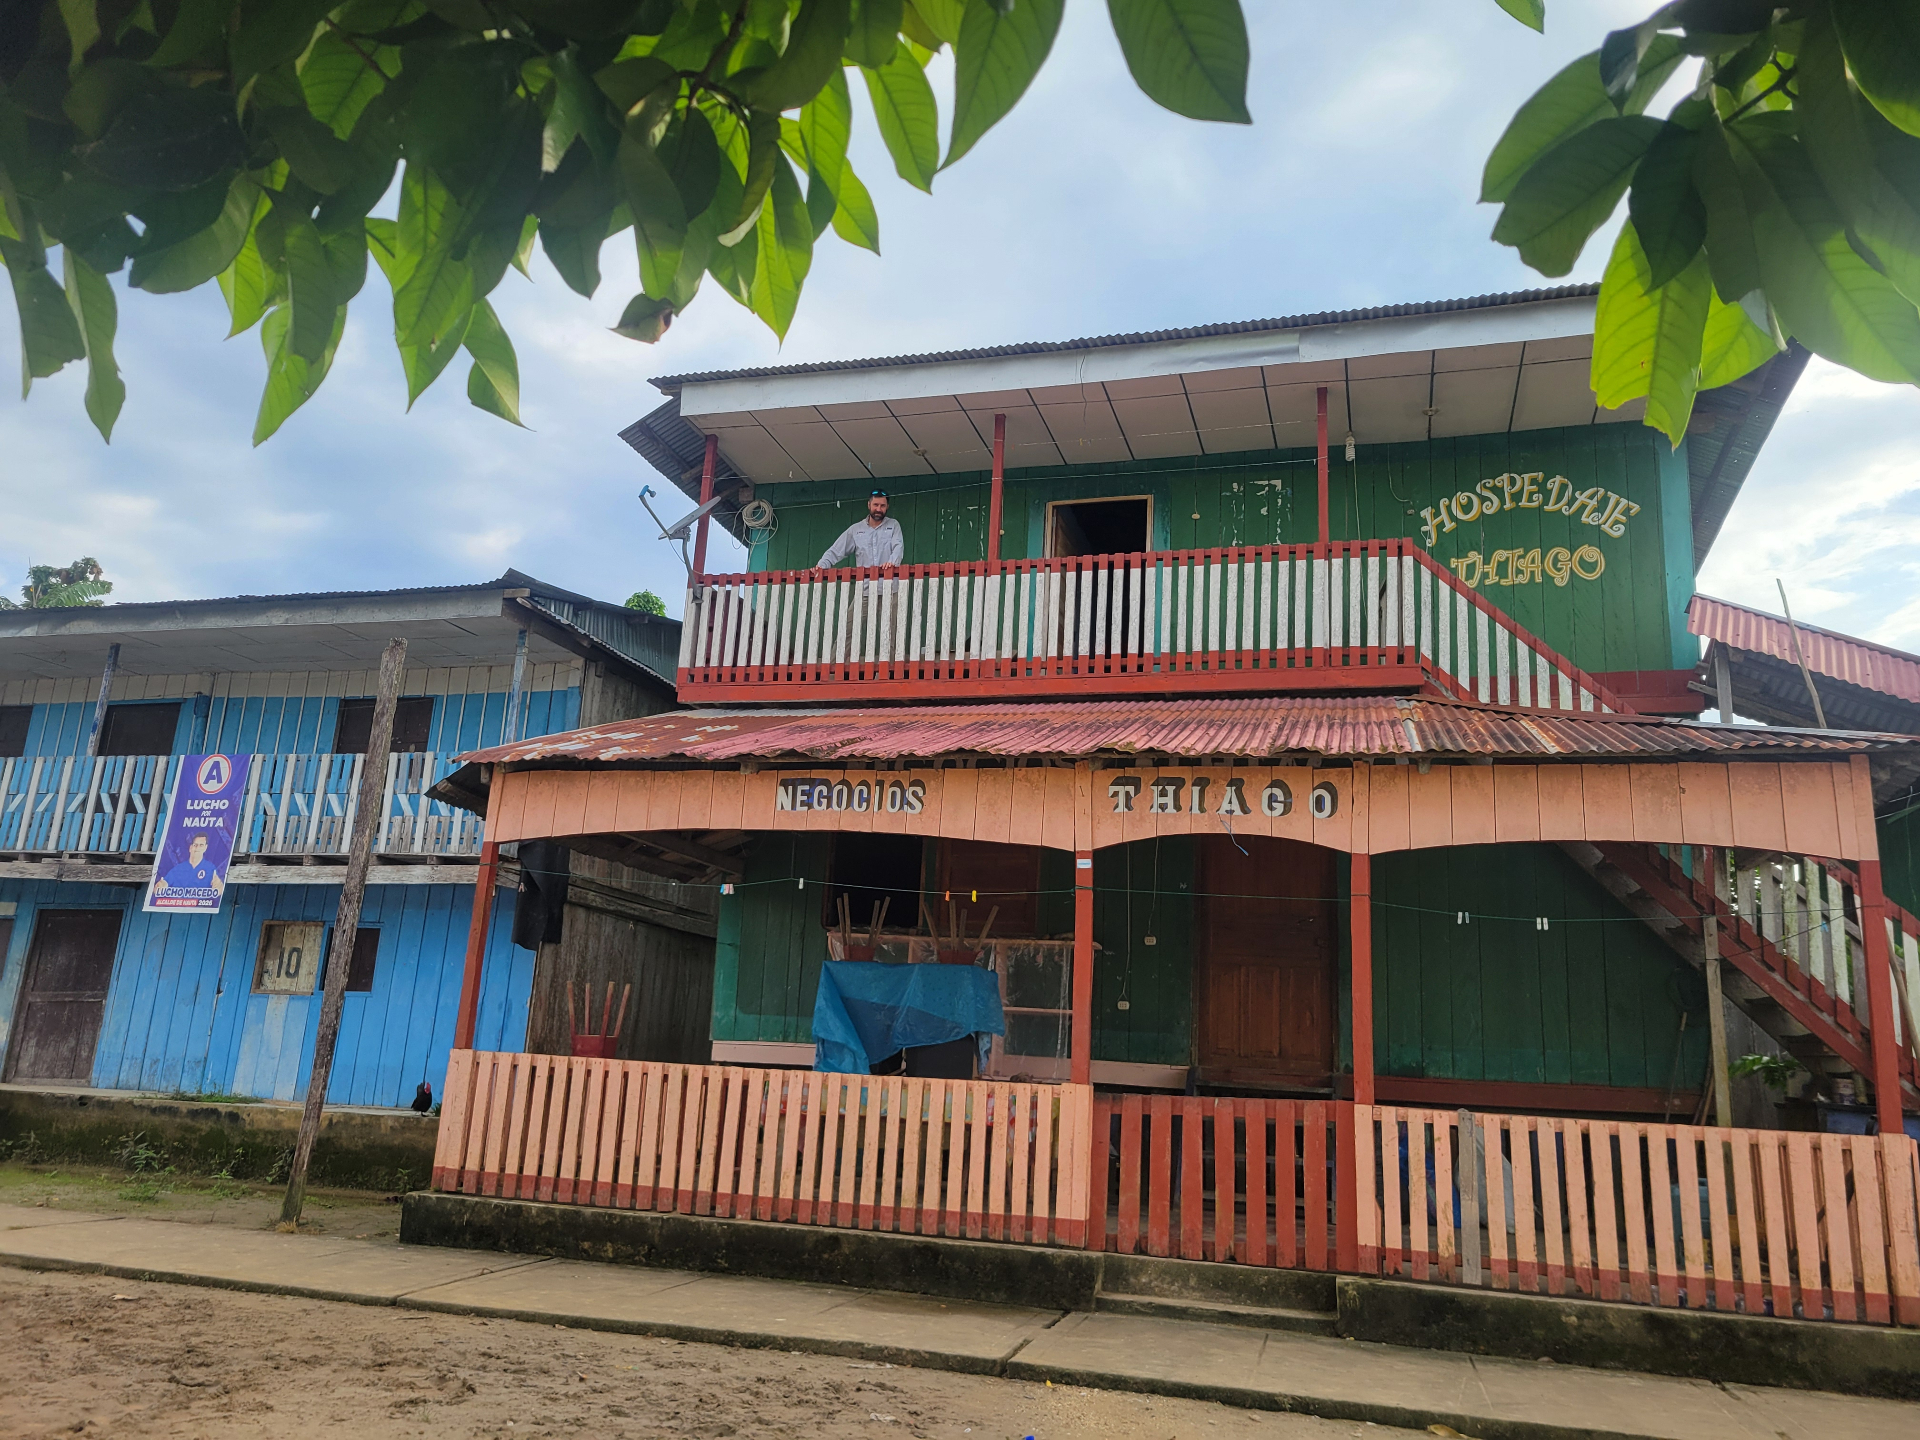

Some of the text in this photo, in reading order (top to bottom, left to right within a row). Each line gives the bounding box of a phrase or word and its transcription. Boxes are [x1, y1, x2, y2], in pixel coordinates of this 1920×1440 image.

[1420, 472, 1641, 547] HOSPEDAJE
[1450, 544, 1606, 588] THIAGO
[203, 760, 223, 785] A
[186, 799, 230, 810] LUCHO
[776, 779, 925, 814] NEGOCIOS
[1108, 777, 1337, 818] THIAGO
[182, 817, 224, 828] NAUTA
[156, 887, 219, 898] LUCHO MACEDO
[276, 947, 302, 979] 10
